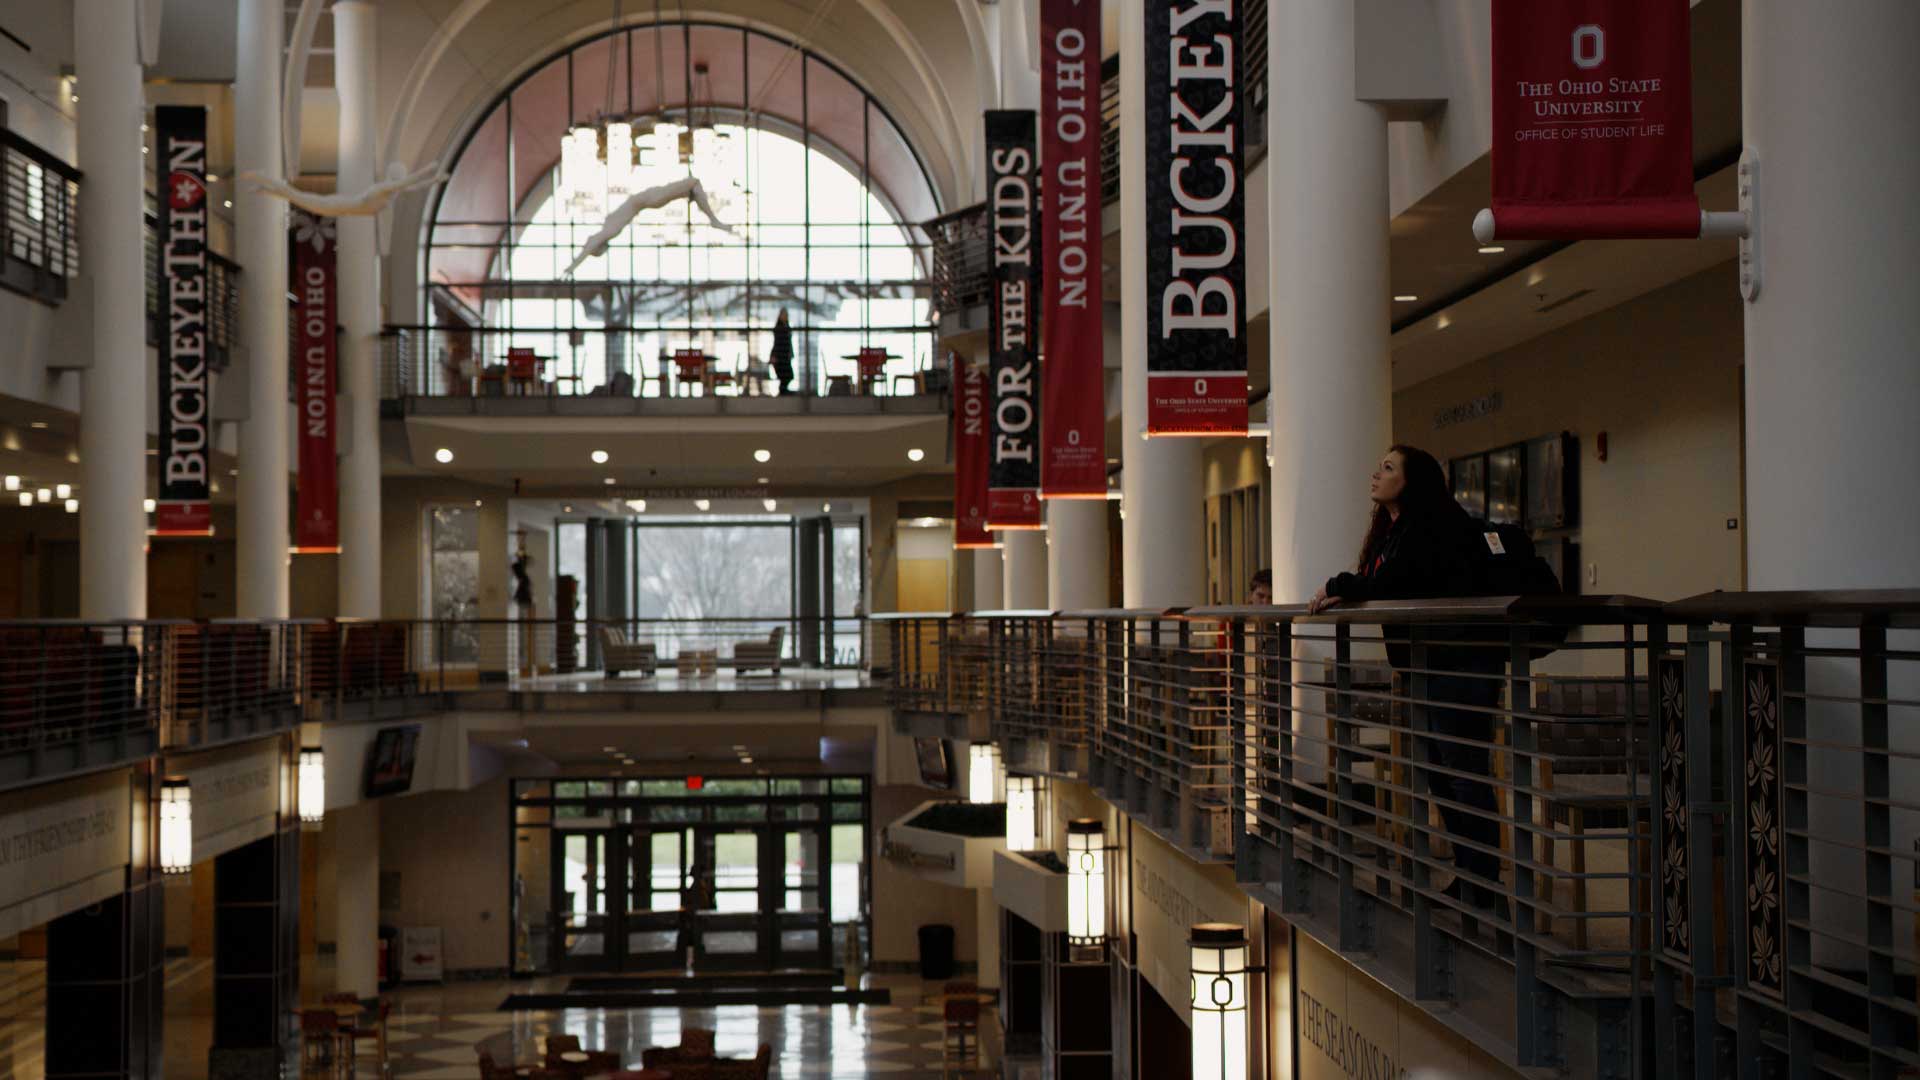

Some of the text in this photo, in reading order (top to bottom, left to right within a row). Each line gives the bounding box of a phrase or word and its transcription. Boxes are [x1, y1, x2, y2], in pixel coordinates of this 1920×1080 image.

[1516, 77, 1662, 97] THE OHIO STATE
[1533, 100, 1645, 116] UNIVERSITY
[1055, 26, 1088, 310] OHIO UNION
[1514, 124, 1665, 142] OFFICE OF STUDENT LIFE
[992, 146, 1032, 269] KIDS
[1001, 279, 1027, 351] THE
[305, 266, 328, 439] OHIO UNION
[996, 361, 1033, 465] FOR
[1300, 990, 1323, 1050] THE
